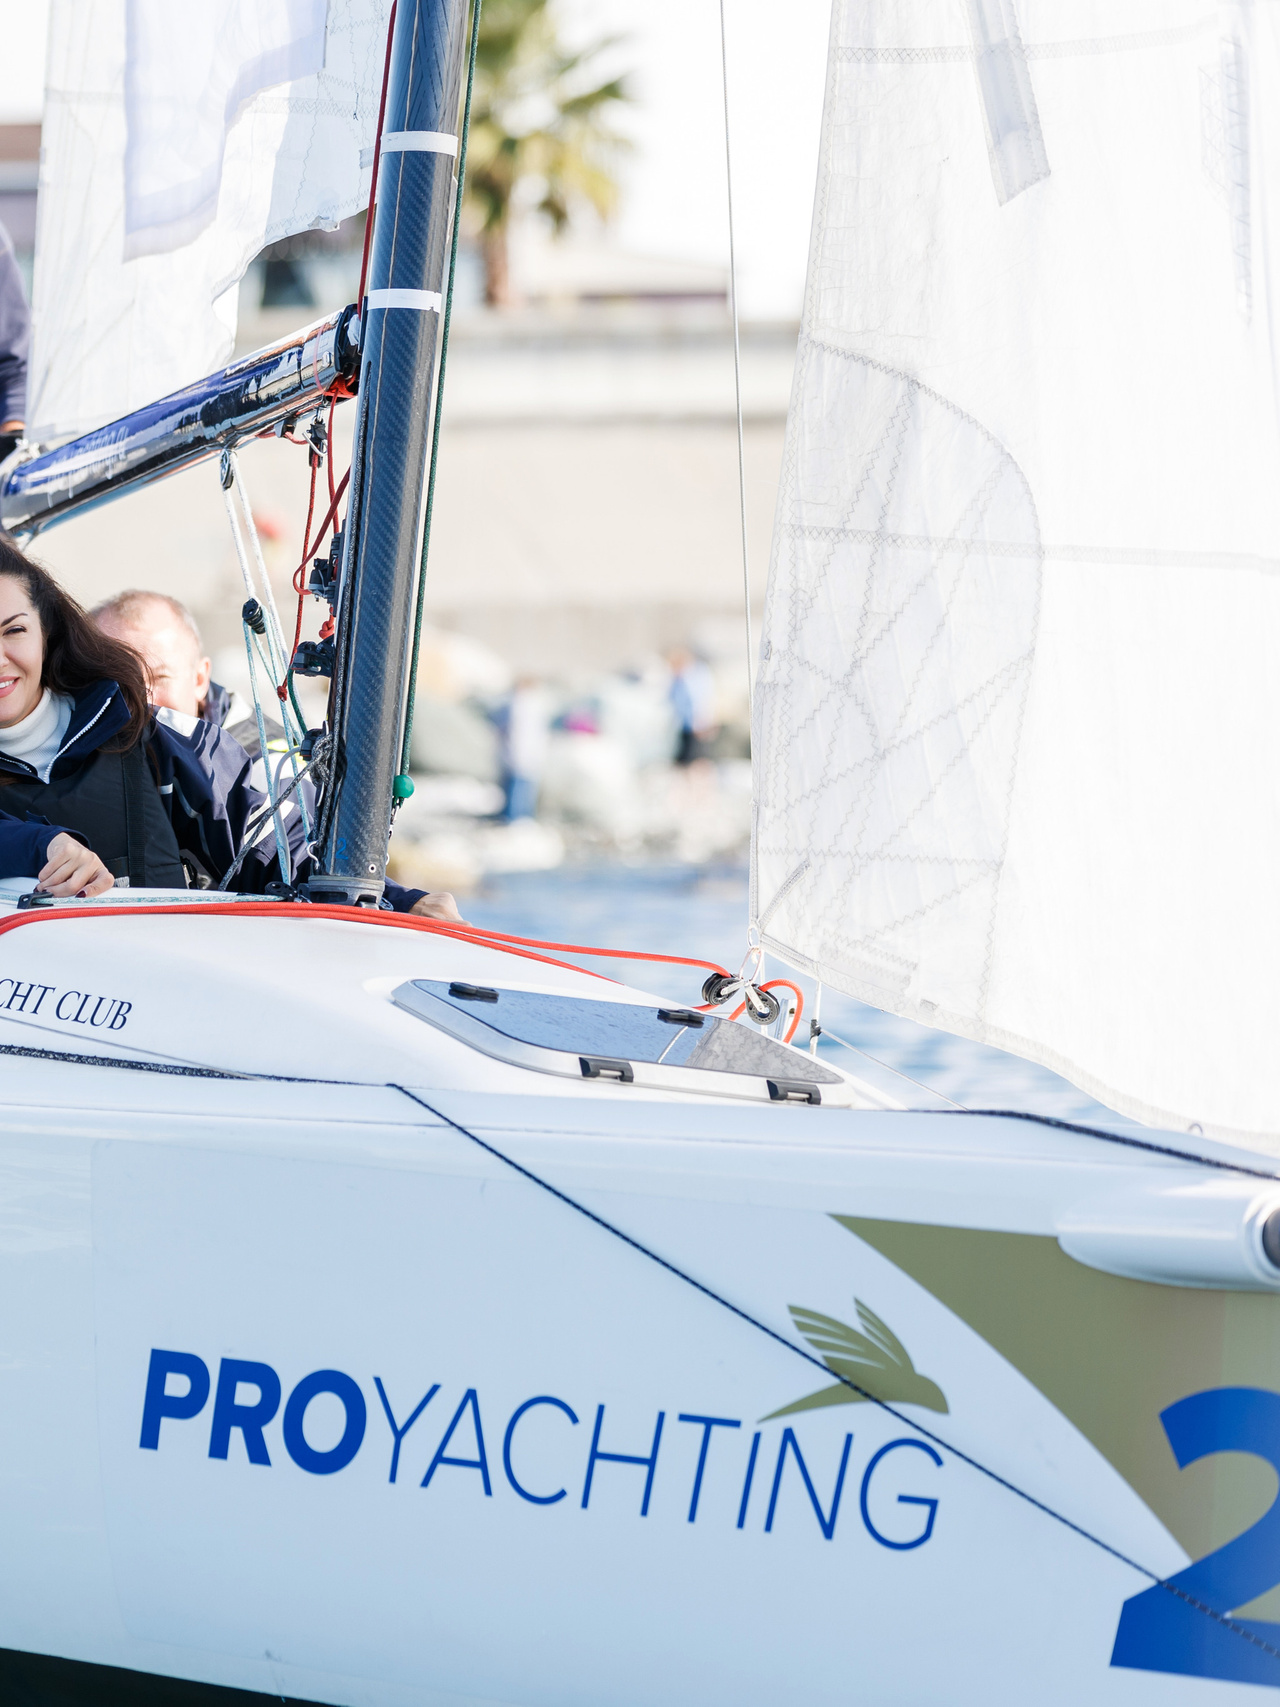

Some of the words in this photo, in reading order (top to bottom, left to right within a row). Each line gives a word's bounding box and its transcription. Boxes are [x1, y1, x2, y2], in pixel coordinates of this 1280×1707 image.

[335, 837, 349, 860] 2
[55, 990, 133, 1031] CLUB
[139, 1348, 946, 1552] PROYACHTING
